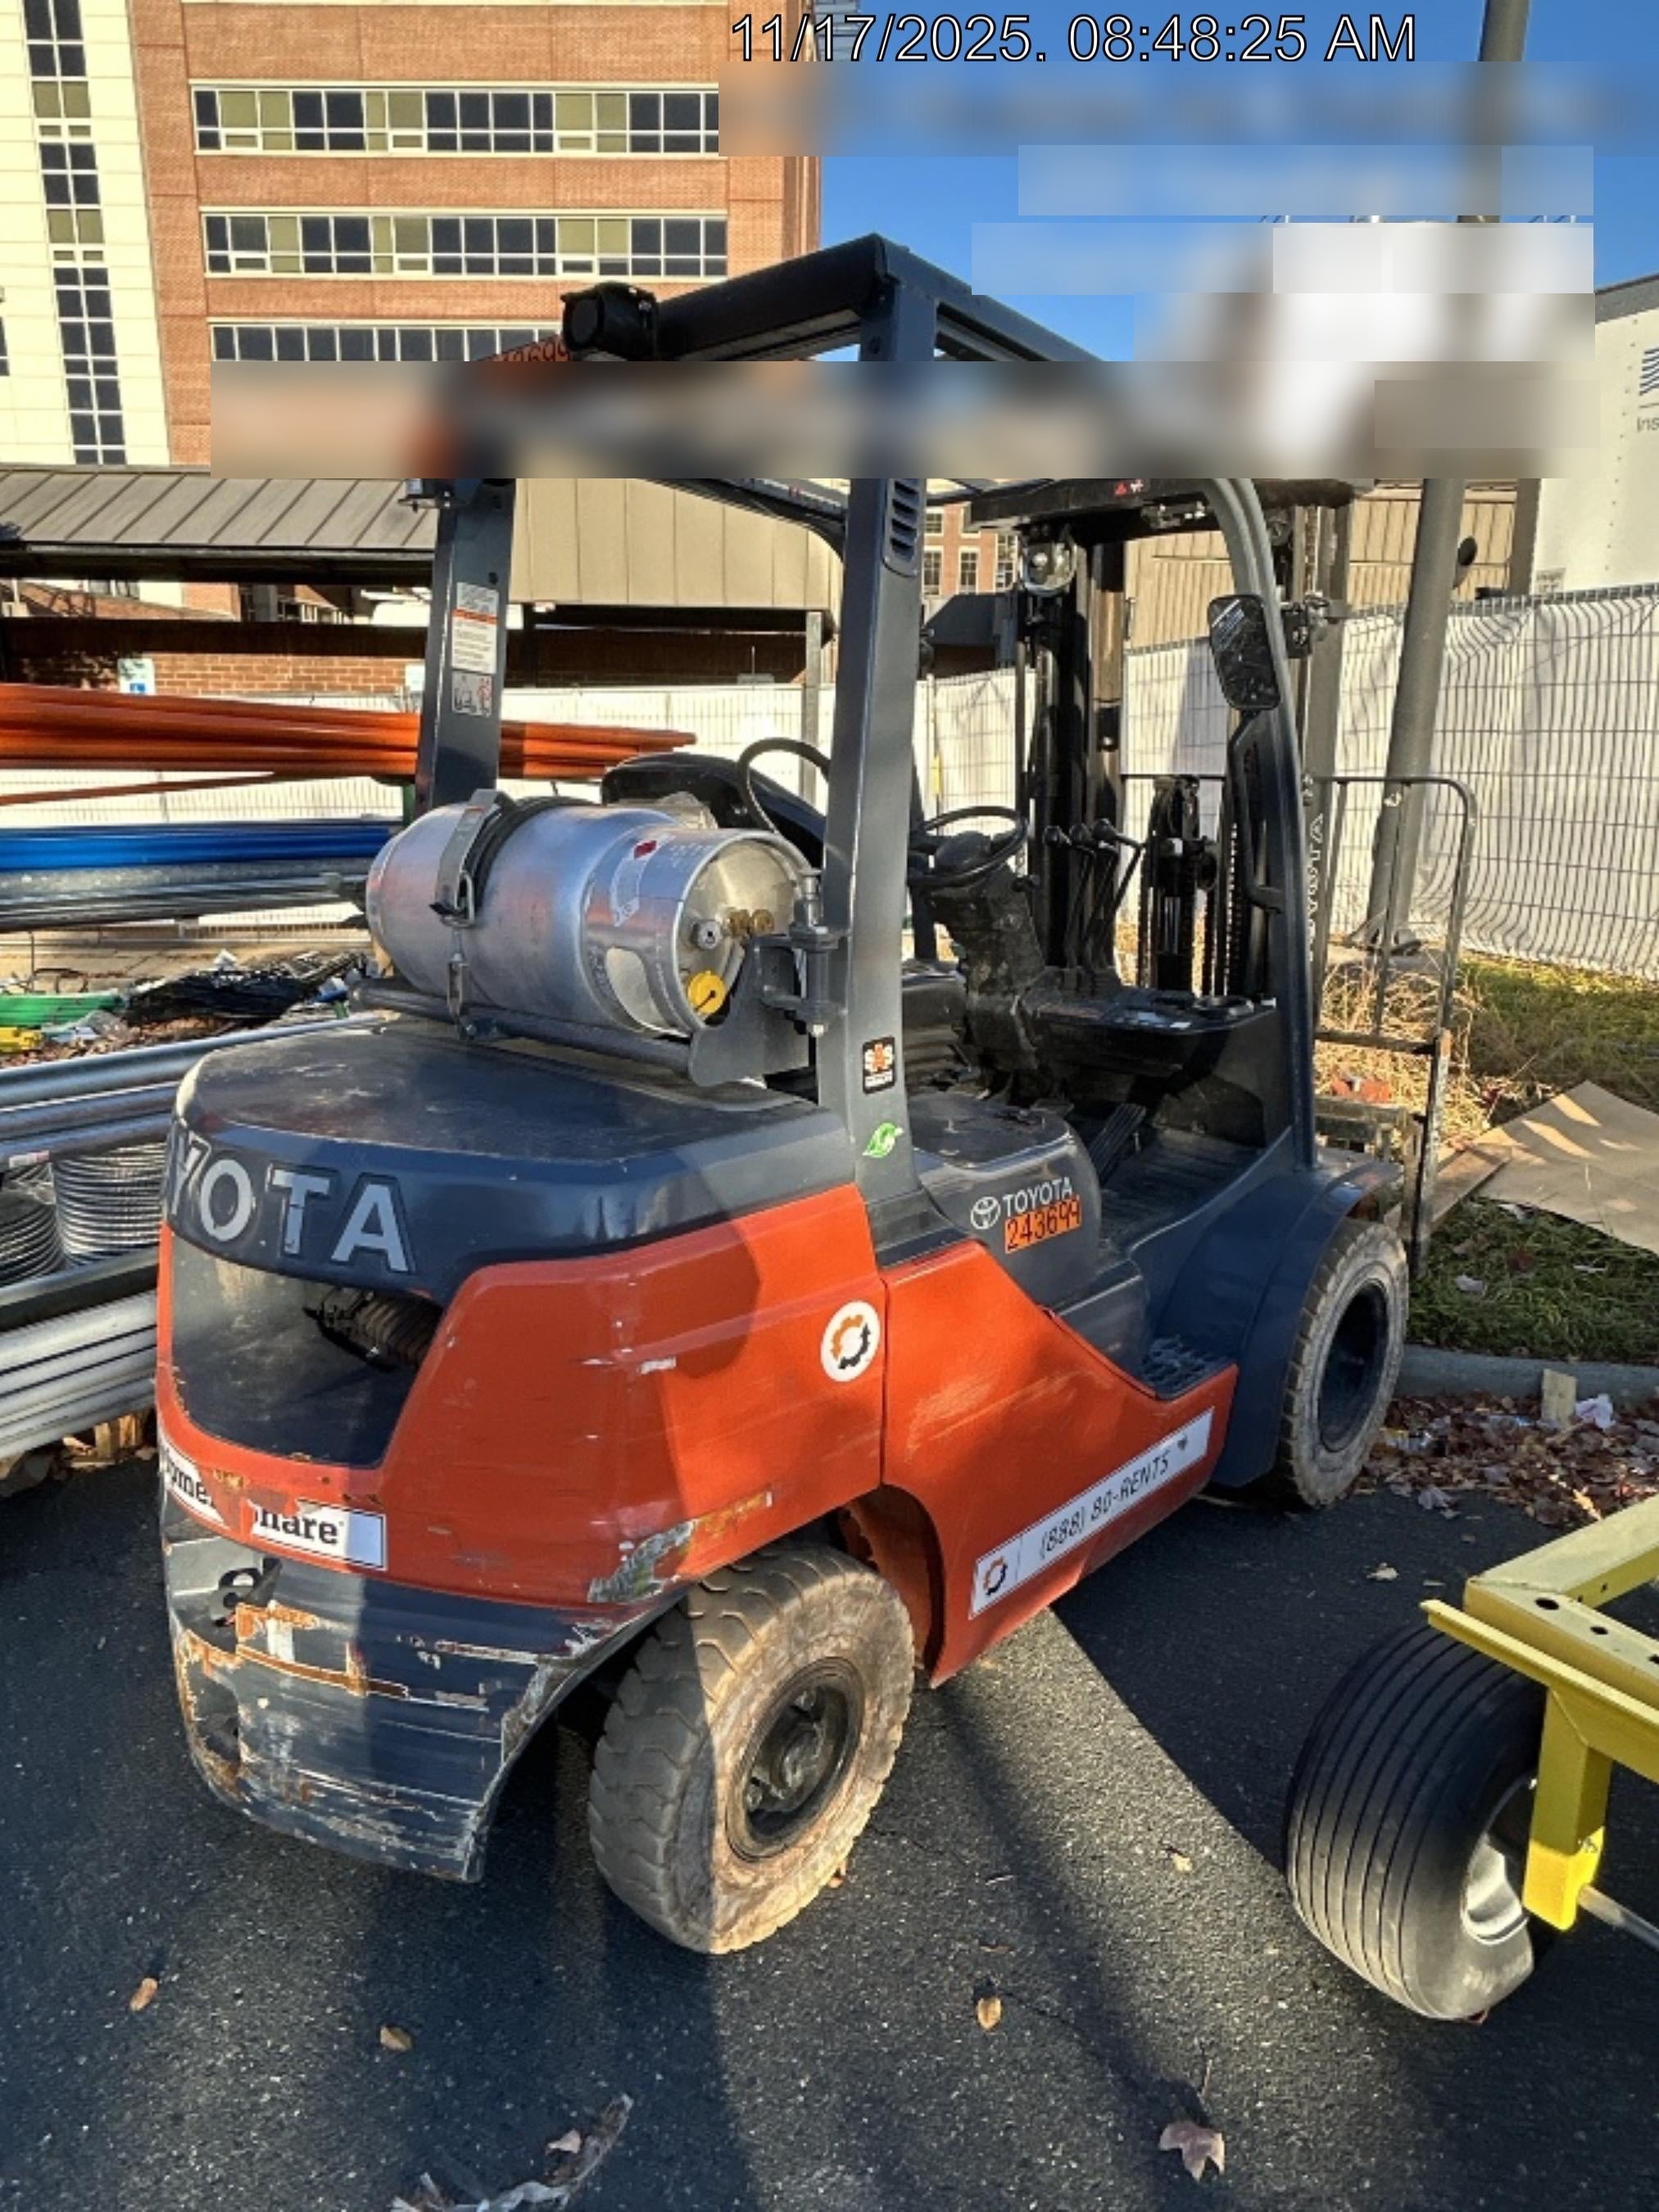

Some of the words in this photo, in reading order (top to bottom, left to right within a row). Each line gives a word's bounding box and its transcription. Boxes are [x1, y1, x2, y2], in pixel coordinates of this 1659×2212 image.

[1002, 1176, 1073, 1217] TOYOTA
[1040, 1506, 1086, 1558] (888)
[1090, 1448, 1170, 1521] 80-RENTS
